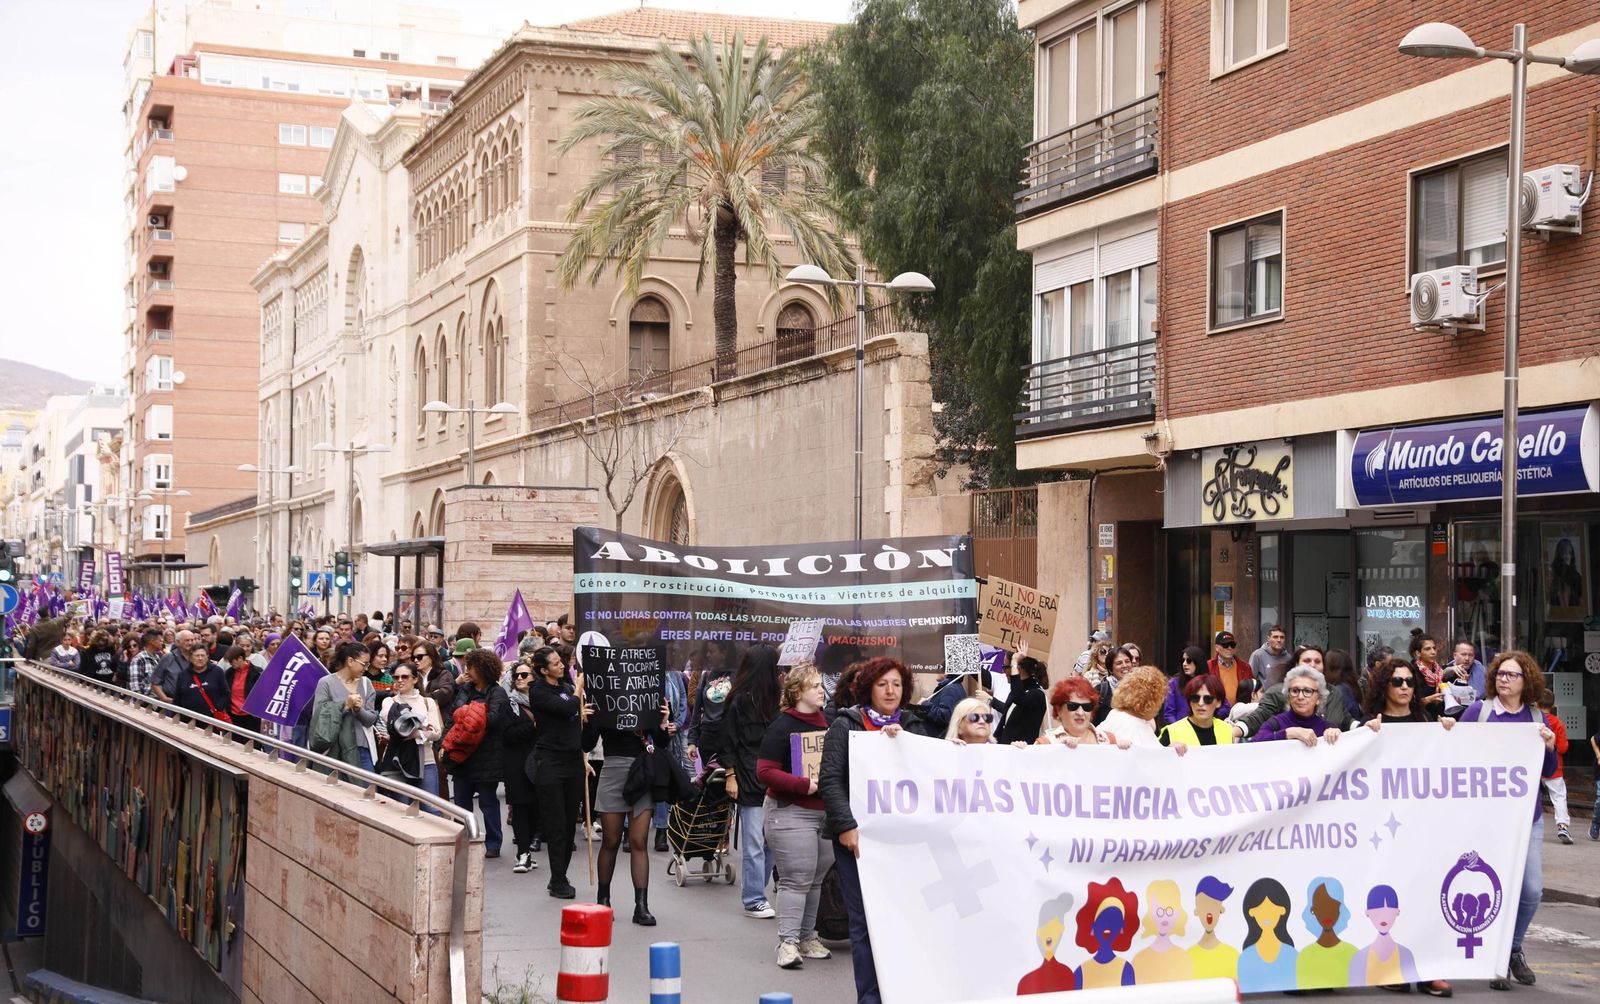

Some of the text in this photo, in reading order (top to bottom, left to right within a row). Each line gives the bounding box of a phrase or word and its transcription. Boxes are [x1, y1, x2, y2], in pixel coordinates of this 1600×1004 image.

[1388, 424, 1566, 471] Mundo Caello
[1398, 465, 1553, 490] ARTÍCULOS DE PELUQUERÍA STÉTICA
[80, 562, 94, 591] CCO
[579, 578, 970, 601] Género Prostitución Pornografía Vientres de alquiler
[1017, 587, 1035, 605] NO
[1039, 595, 1058, 612] ERA
[990, 595, 1042, 621] UNA ZORRA
[1365, 595, 1421, 608] LA TREMENDA
[585, 611, 596, 620] SI
[598, 611, 612, 620] NO
[614, 611, 651, 620] LUCHAS
[653, 611, 692, 620] CONTRA
[695, 612, 727, 621] TODAS
[729, 613, 749, 622] LAS
[844, 618, 862, 627] LAS
[863, 618, 907, 628] MUJERES
[908, 615, 967, 626] (FEMINISMO)
[986, 609, 996, 621] EL
[1033, 624, 1049, 636] ERAS
[660, 629, 692, 640] ERES
[694, 630, 732, 641] PARTE
[735, 631, 757, 641] DEL
[827, 634, 898, 648] (MACHISMO)
[589, 647, 657, 659] SI TE ATREVES
[607, 660, 660, 673] A TOCARME
[924, 663, 939, 671] aquí
[586, 673, 660, 690] NO TE ATREVAS
[605, 692, 661, 712] DORMIR
[866, 765, 1529, 820] NO MÁS VIOLENCIA CONTRA LAS MUJERES
[1068, 821, 1358, 864] NI PARAMOS NI CALLAMOS
